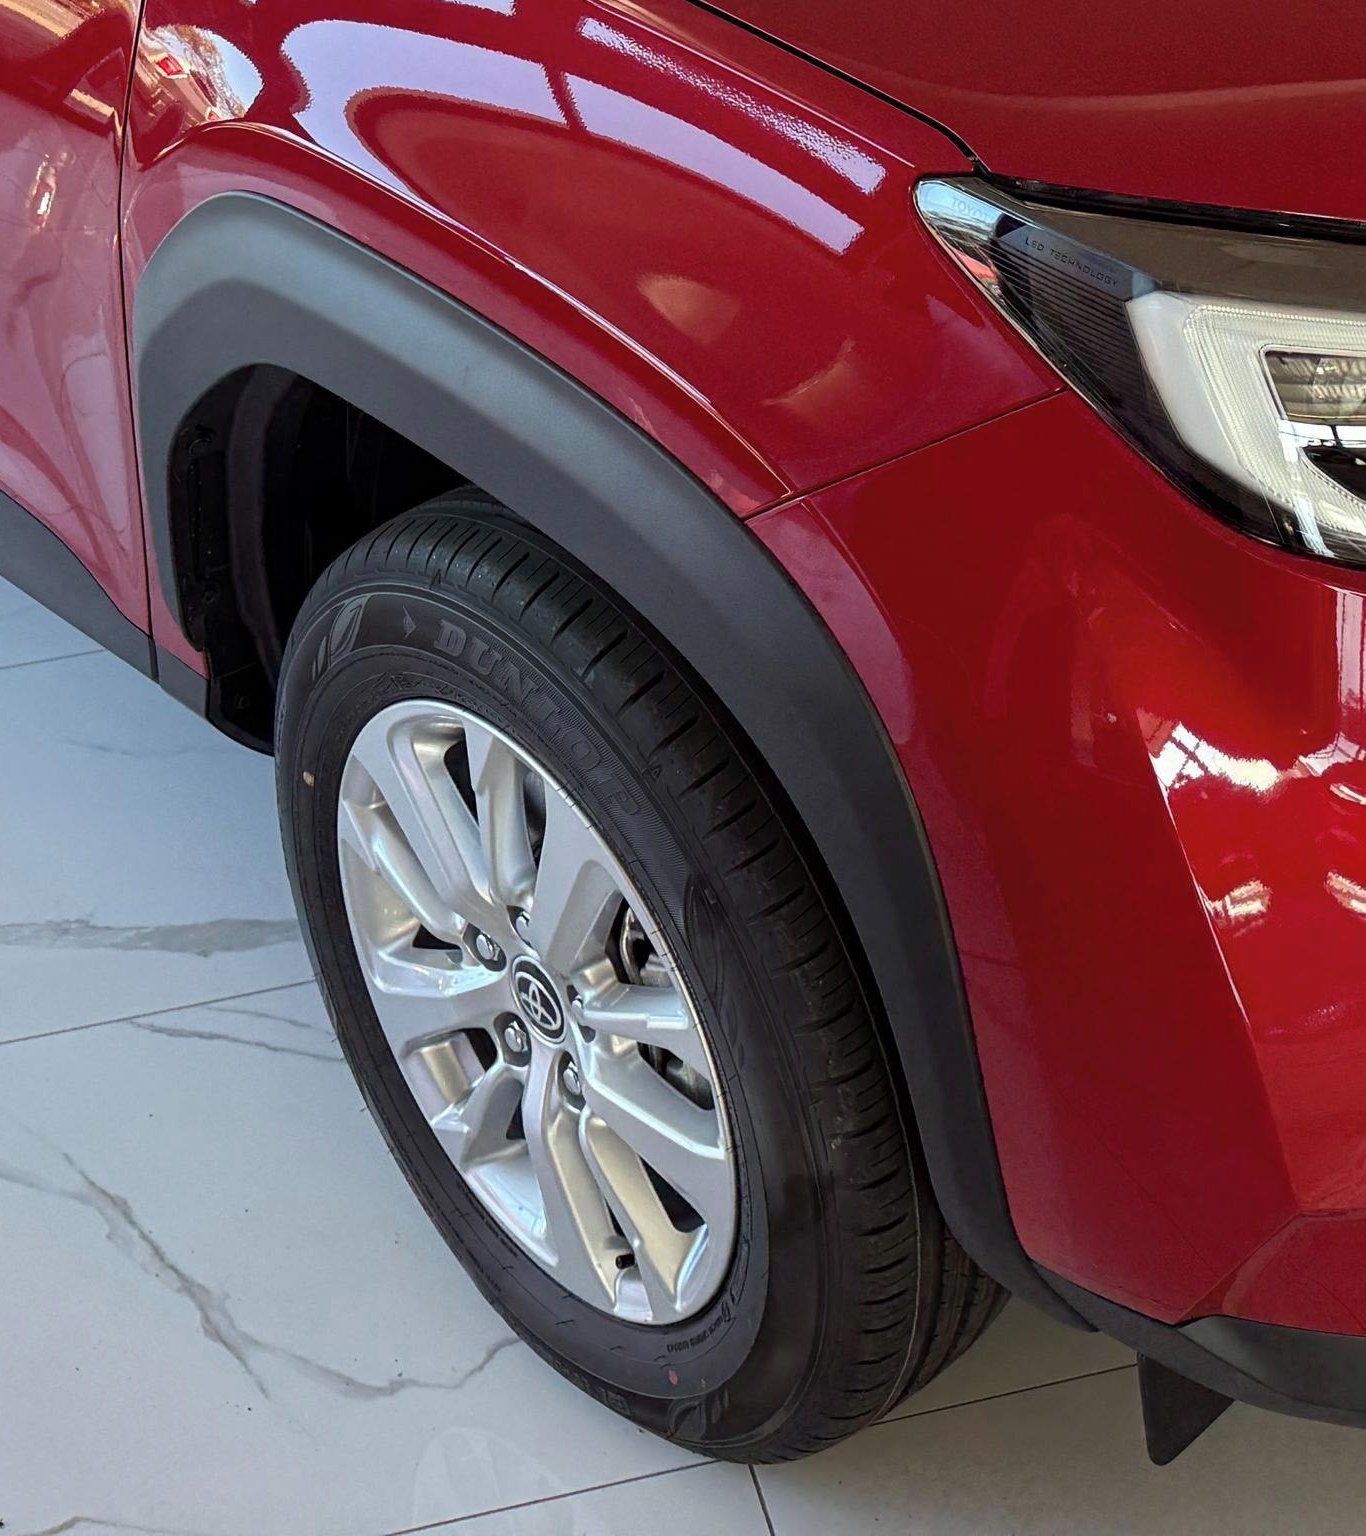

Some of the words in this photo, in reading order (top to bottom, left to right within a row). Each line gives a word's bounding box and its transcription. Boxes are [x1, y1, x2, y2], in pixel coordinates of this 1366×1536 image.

[1025, 236, 1045, 252] LED
[1049, 248, 1120, 287] TECHNOLOGY
[434, 618, 641, 816] DUNLOP
